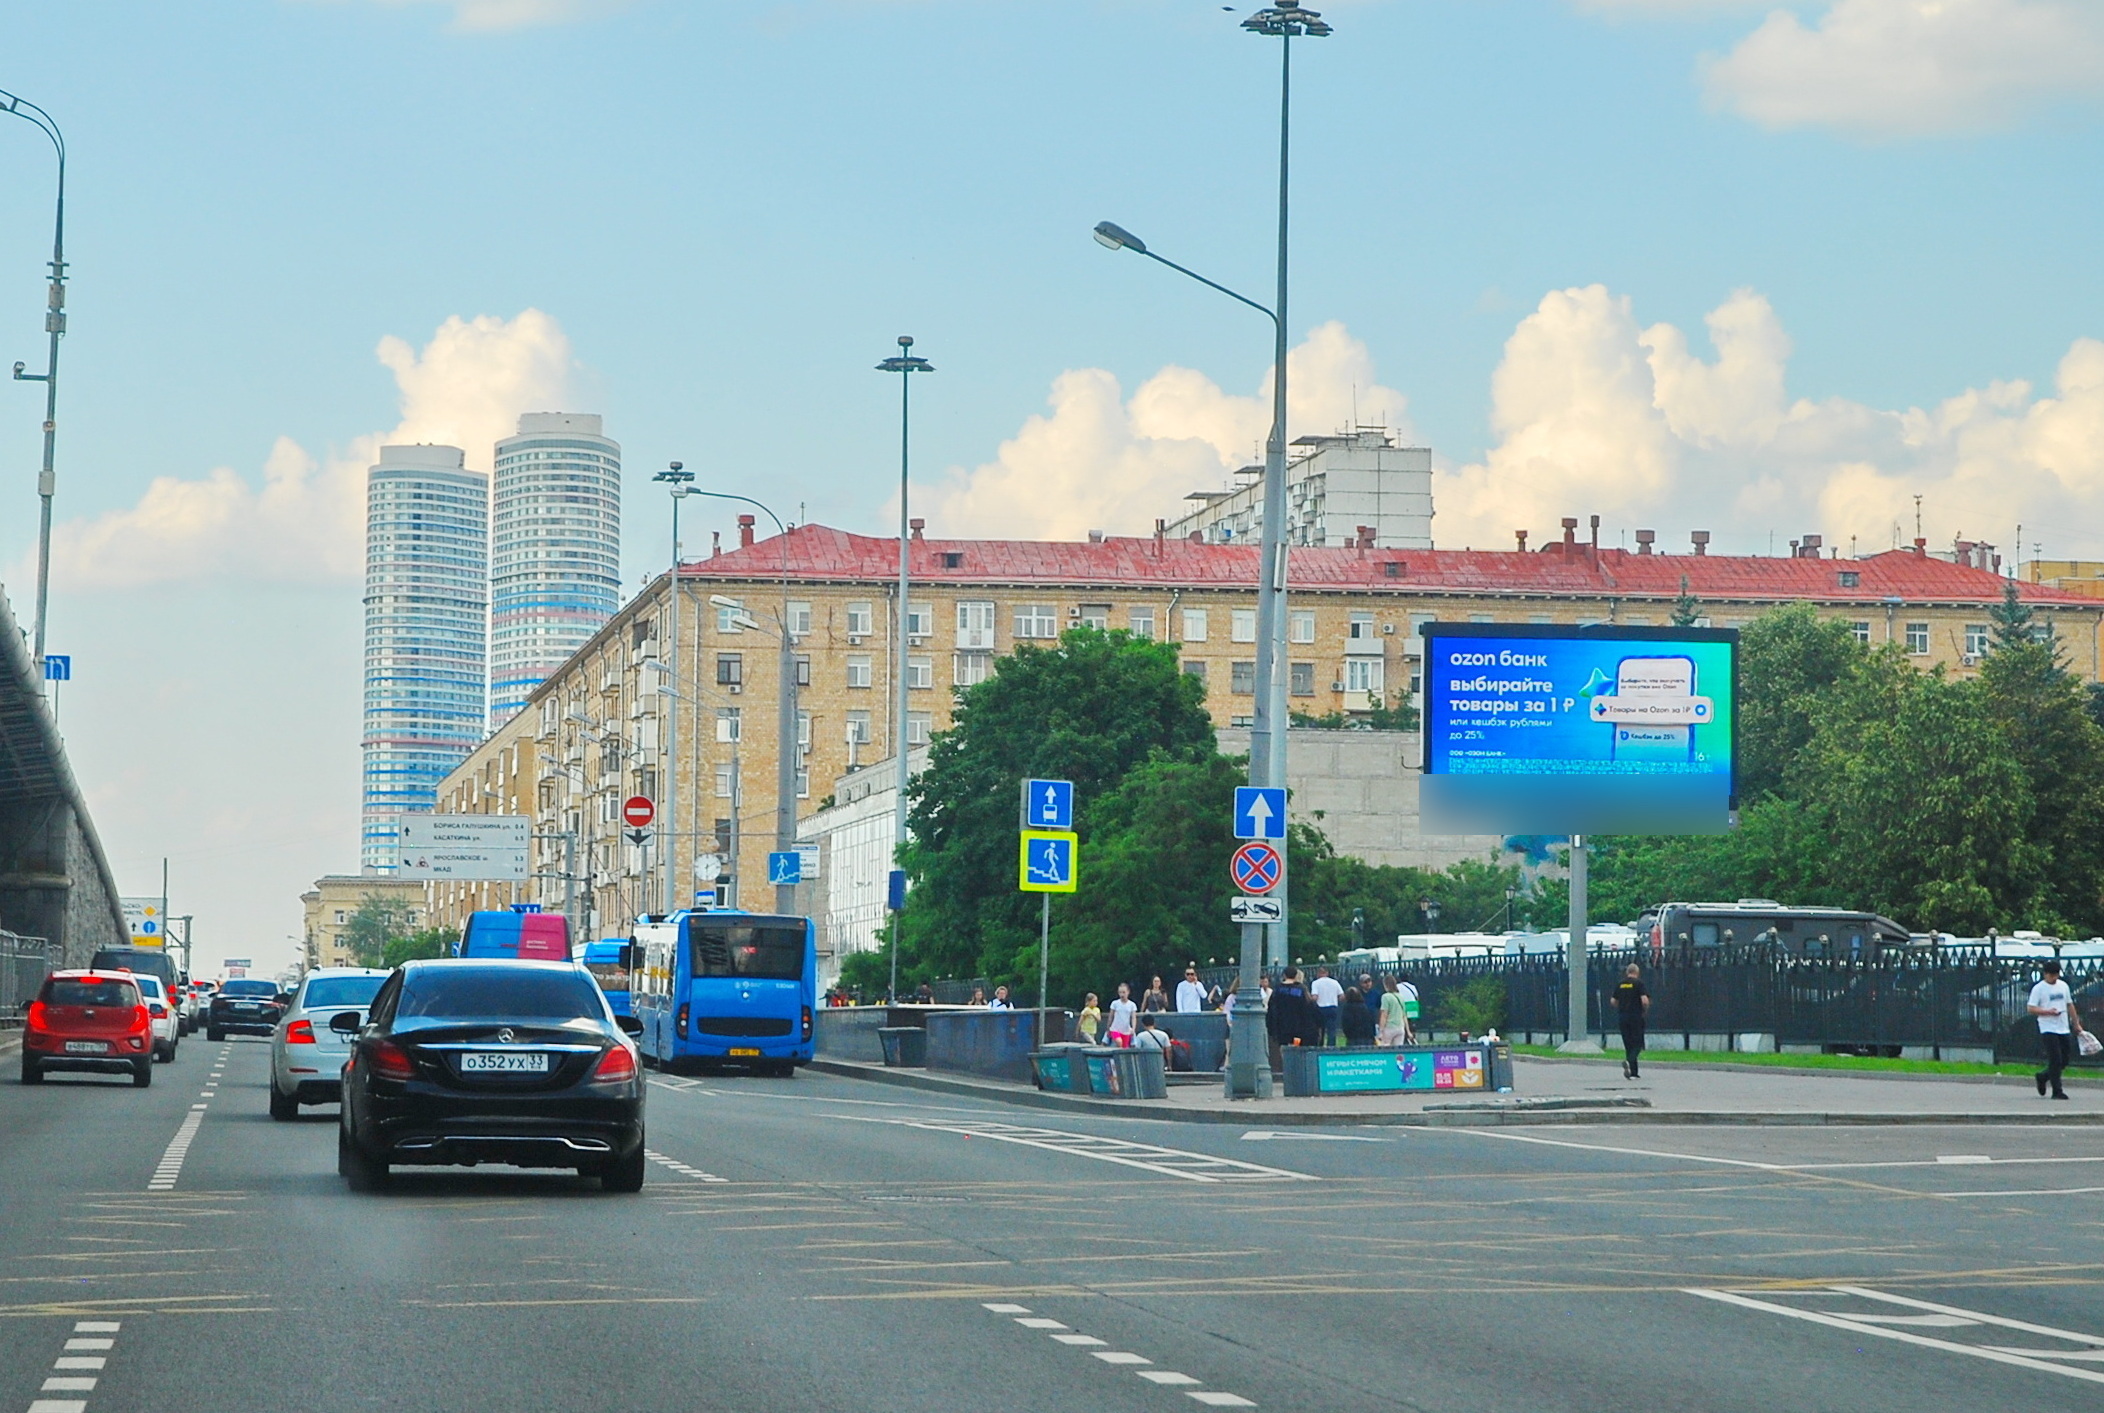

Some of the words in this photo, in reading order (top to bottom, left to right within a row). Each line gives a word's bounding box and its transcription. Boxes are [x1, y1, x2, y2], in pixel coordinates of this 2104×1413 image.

[1450, 653, 1496, 666] ozon
[1500, 650, 1548, 667] банк
[1450, 675, 1553, 695] выбирайте
[1449, 699, 1519, 715] товары
[1523, 700, 1546, 713] за
[1550, 697, 1557, 713] 1
[1609, 705, 1636, 714] Товары
[1649, 705, 1670, 714] Ozon
[1450, 718, 1469, 727] или
[1471, 717, 1508, 727] кешбэк
[1509, 718, 1553, 728] рублями
[1449, 731, 1463, 740] до
[1464, 730, 1485, 740] 25%
[467, 1055, 525, 1069] О352УХ
[529, 1055, 543, 1066] 33
[1326, 1060, 1350, 1068] ИГРЫ
[1356, 1059, 1387, 1067] МЯЧОМ
[1333, 1068, 1383, 1076] РАКЕТКАМИ
